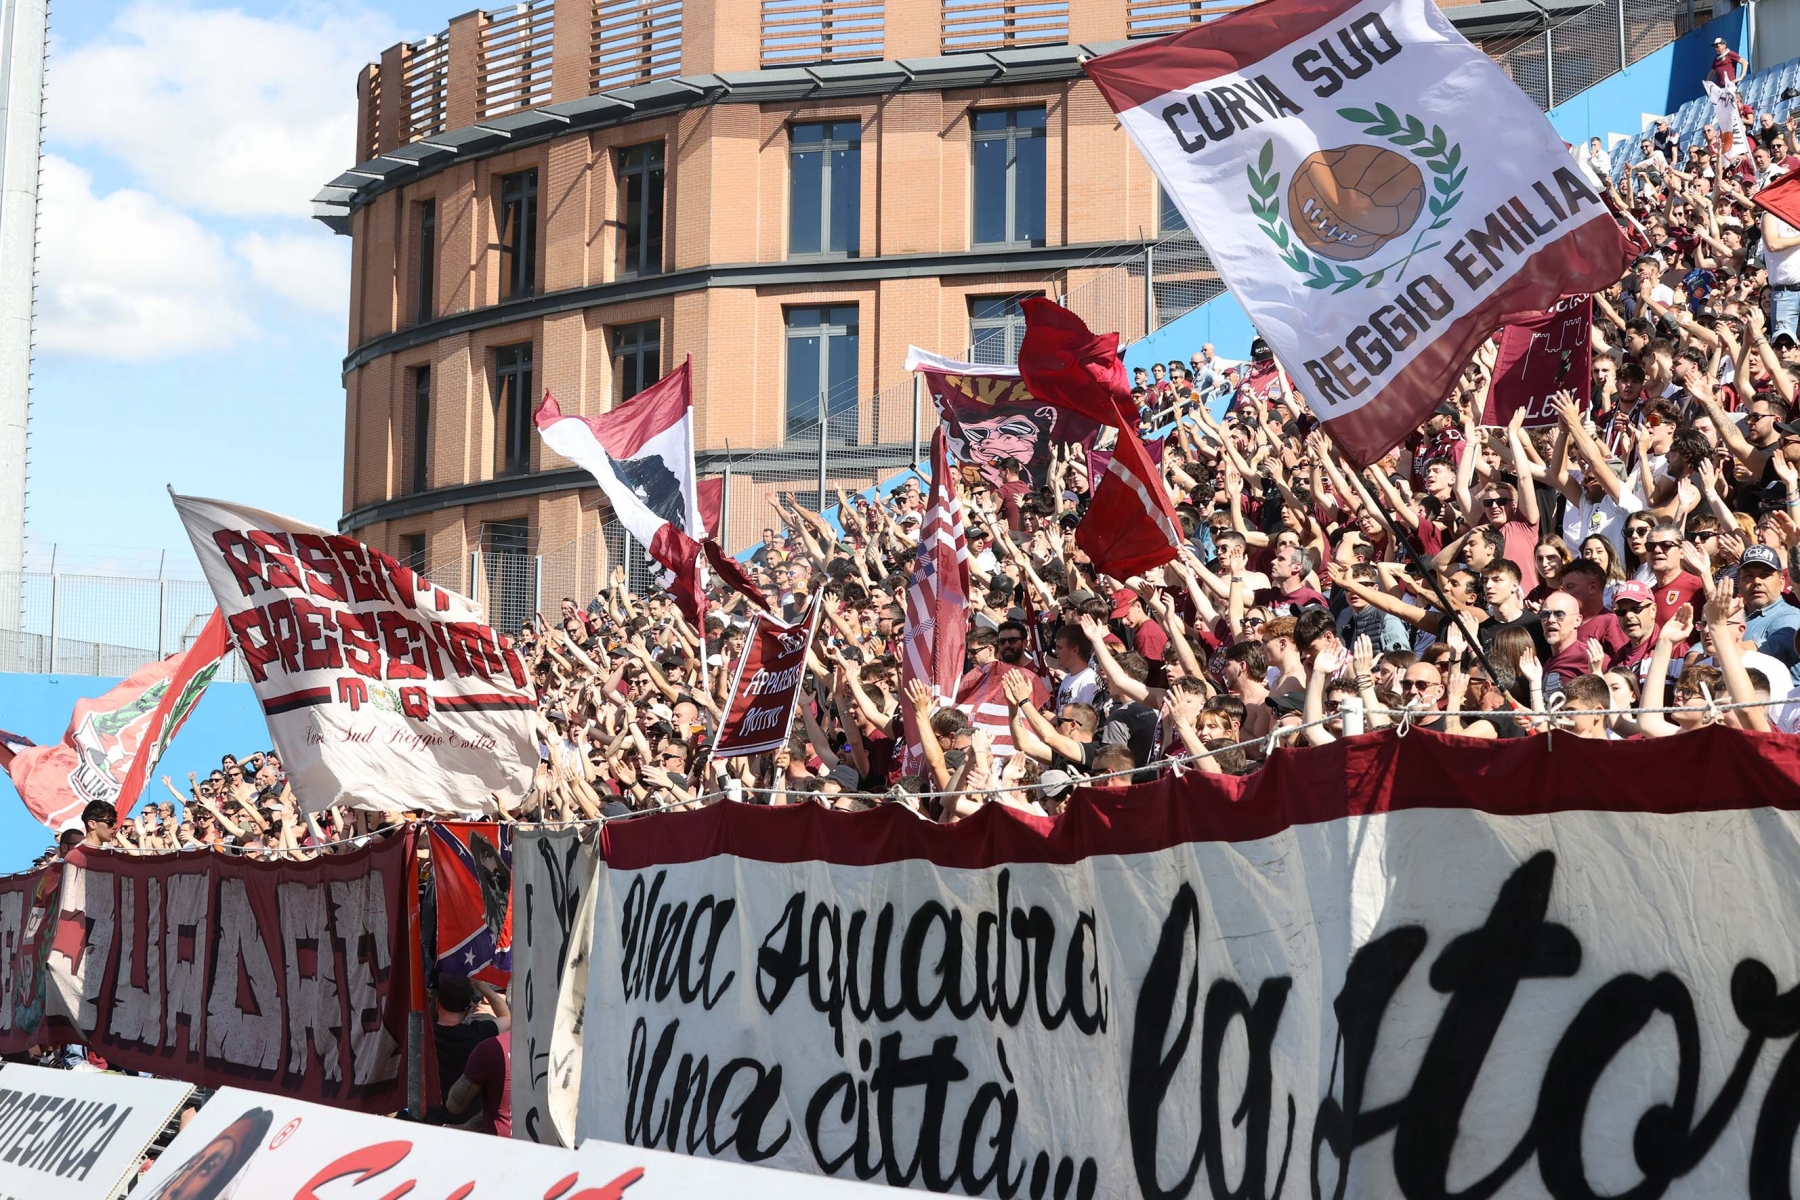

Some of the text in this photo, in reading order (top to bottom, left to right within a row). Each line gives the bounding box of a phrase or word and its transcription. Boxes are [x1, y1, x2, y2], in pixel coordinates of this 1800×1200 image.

[1161, 11, 1404, 154] CURVA SUD
[1302, 166, 1602, 406] REGGIO EMILIA
[229, 598, 527, 690] PRESENTI
[338, 677, 430, 722] T Q
[335, 720, 378, 744] Sud
[381, 721, 445, 752] Reggio
[620, 870, 736, 1010] Una
[756, 868, 1109, 1057] squadra
[625, 1018, 792, 1162] Una
